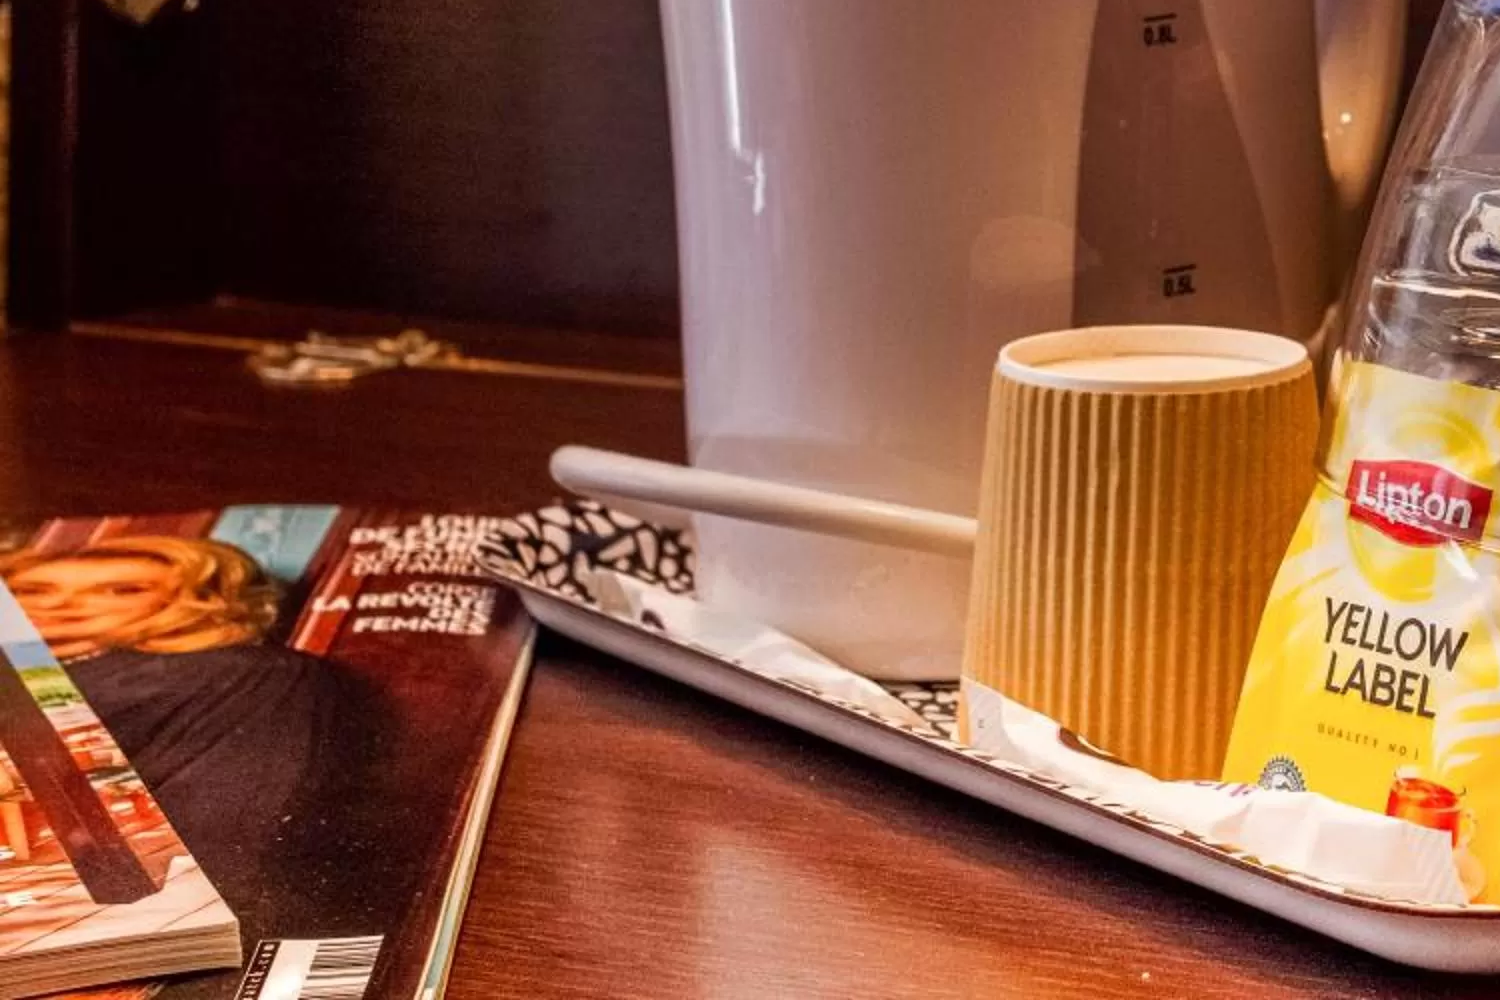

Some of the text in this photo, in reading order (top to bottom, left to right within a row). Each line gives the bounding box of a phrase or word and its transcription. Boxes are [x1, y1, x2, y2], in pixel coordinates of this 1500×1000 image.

[1143, 23, 1177, 46] 0.8L
[1163, 273, 1196, 297] 0.5L
[1356, 469, 1473, 530] Lipton
[352, 616, 488, 635] FEMMES
[1324, 597, 1470, 672] YELLOW
[1323, 651, 1437, 719] LABEL
